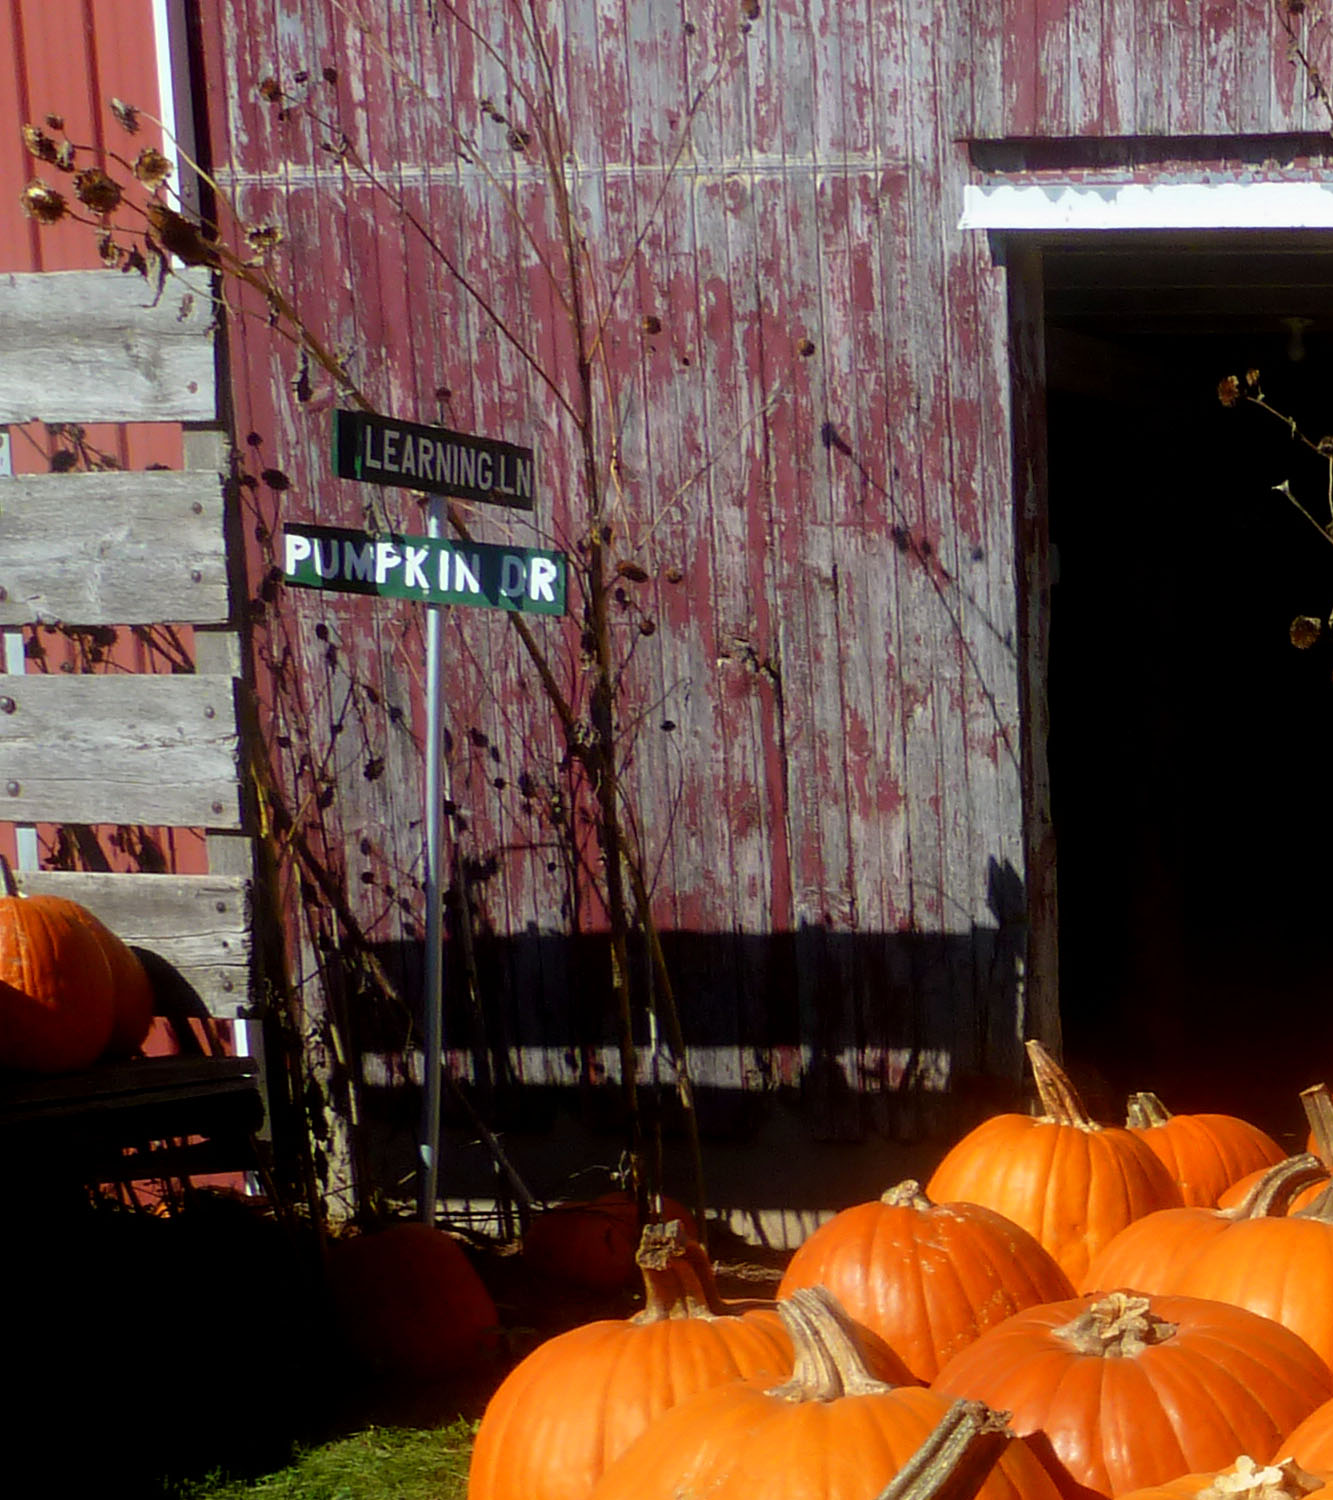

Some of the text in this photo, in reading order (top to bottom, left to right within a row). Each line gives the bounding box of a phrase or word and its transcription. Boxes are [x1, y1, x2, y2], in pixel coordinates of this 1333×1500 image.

[364, 424, 532, 498] LEARNING LN
[284, 534, 557, 602] PUMPKIN DR
